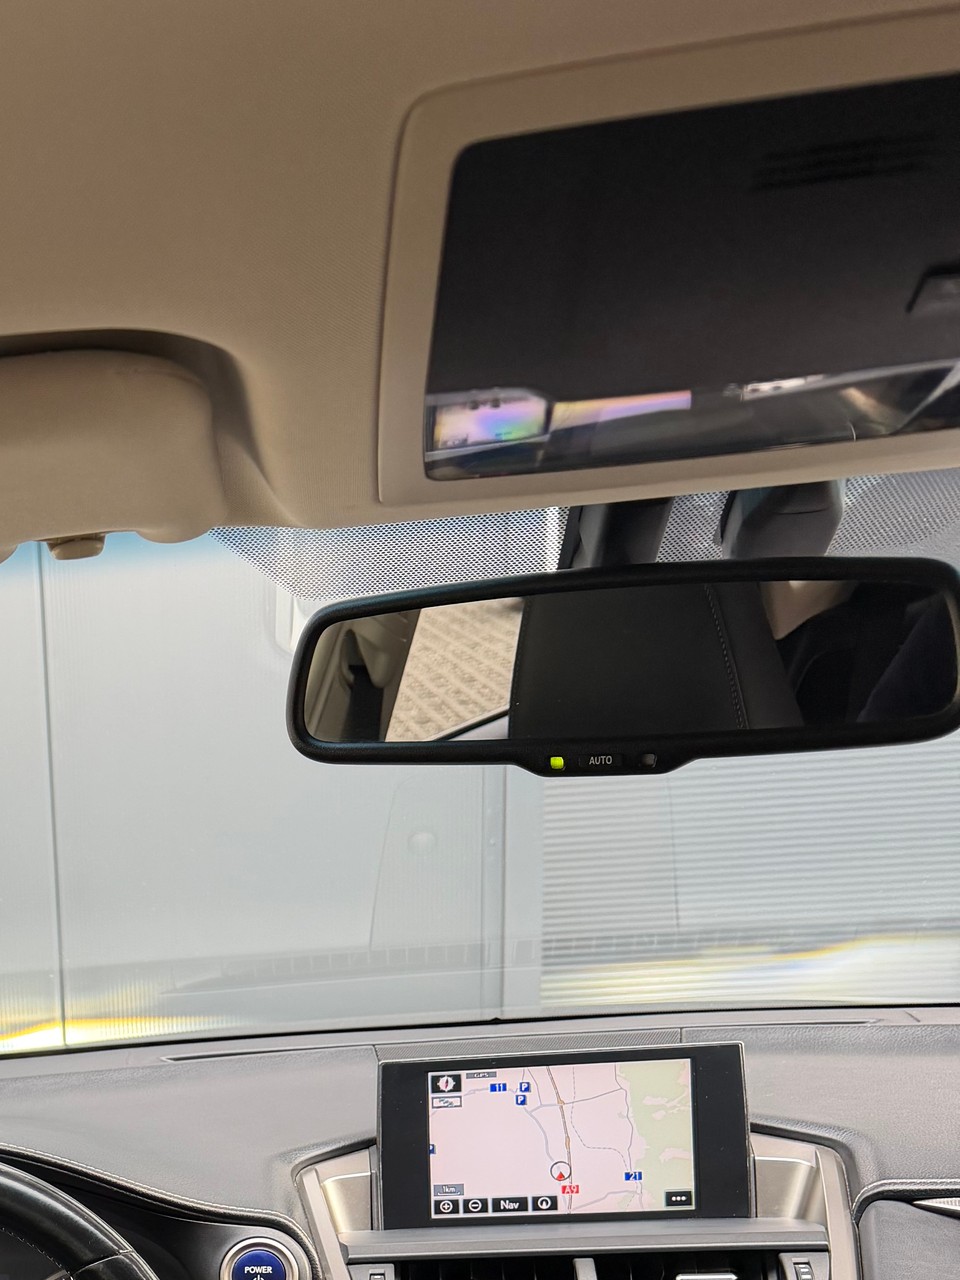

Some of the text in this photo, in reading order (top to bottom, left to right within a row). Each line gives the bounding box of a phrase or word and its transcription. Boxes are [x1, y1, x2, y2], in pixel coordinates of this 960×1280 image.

[589, 755, 613, 765] AUTO
[629, 1172, 640, 1181] 21
[500, 1200, 519, 1210] Nav
[244, 1266, 273, 1274] POWER
